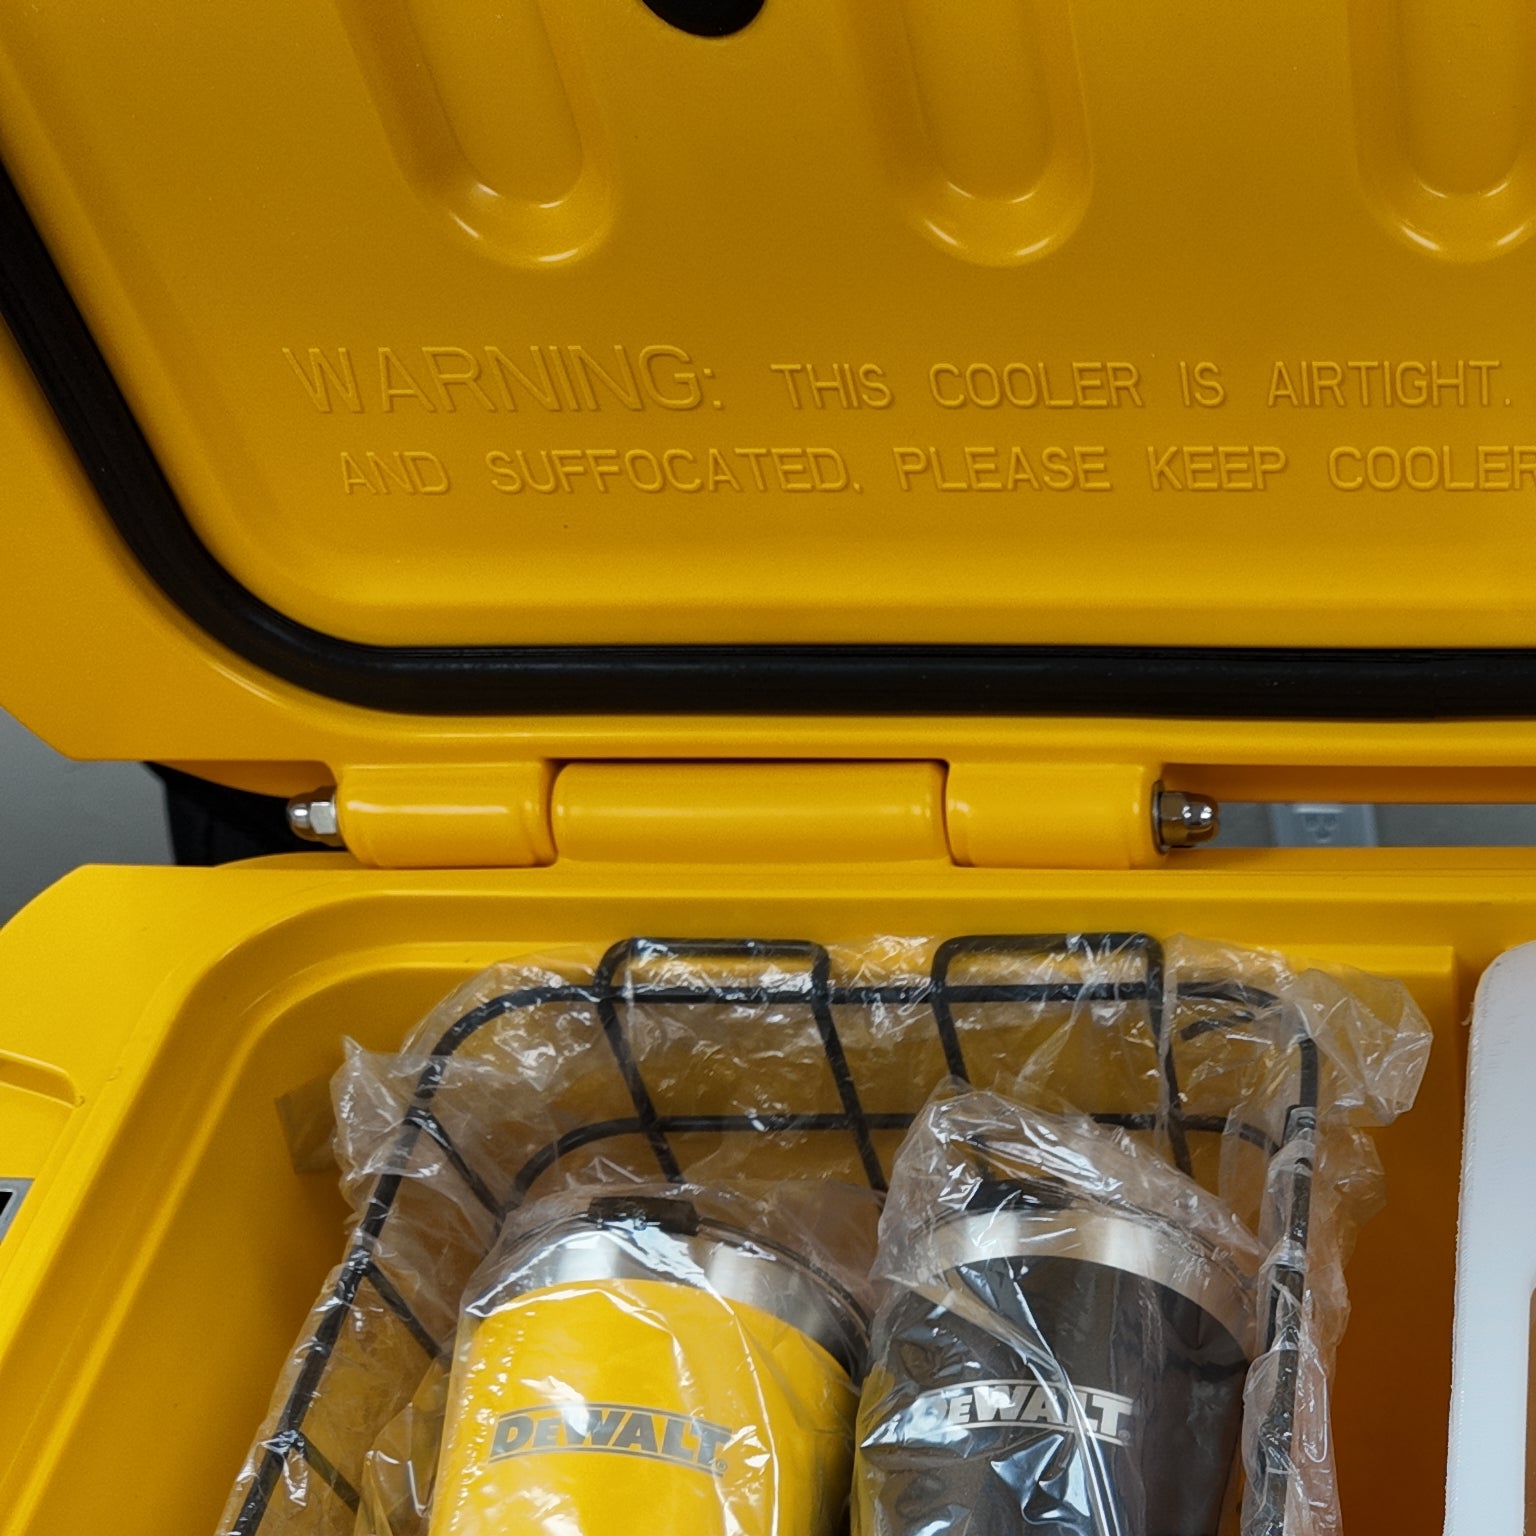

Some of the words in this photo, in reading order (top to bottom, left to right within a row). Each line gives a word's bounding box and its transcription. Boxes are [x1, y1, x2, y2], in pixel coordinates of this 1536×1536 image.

[281, 342, 725, 414] WARNING:
[769, 361, 894, 409] THIS
[927, 360, 1143, 409] COOLER
[1177, 359, 1226, 408] IS
[1266, 358, 1513, 409] AIRTIGHT.
[340, 451, 450, 495] AND
[484, 446, 863, 495] SUFFOCATED.
[891, 444, 1112, 492] PLEASE
[1145, 444, 1287, 491] KEEP
